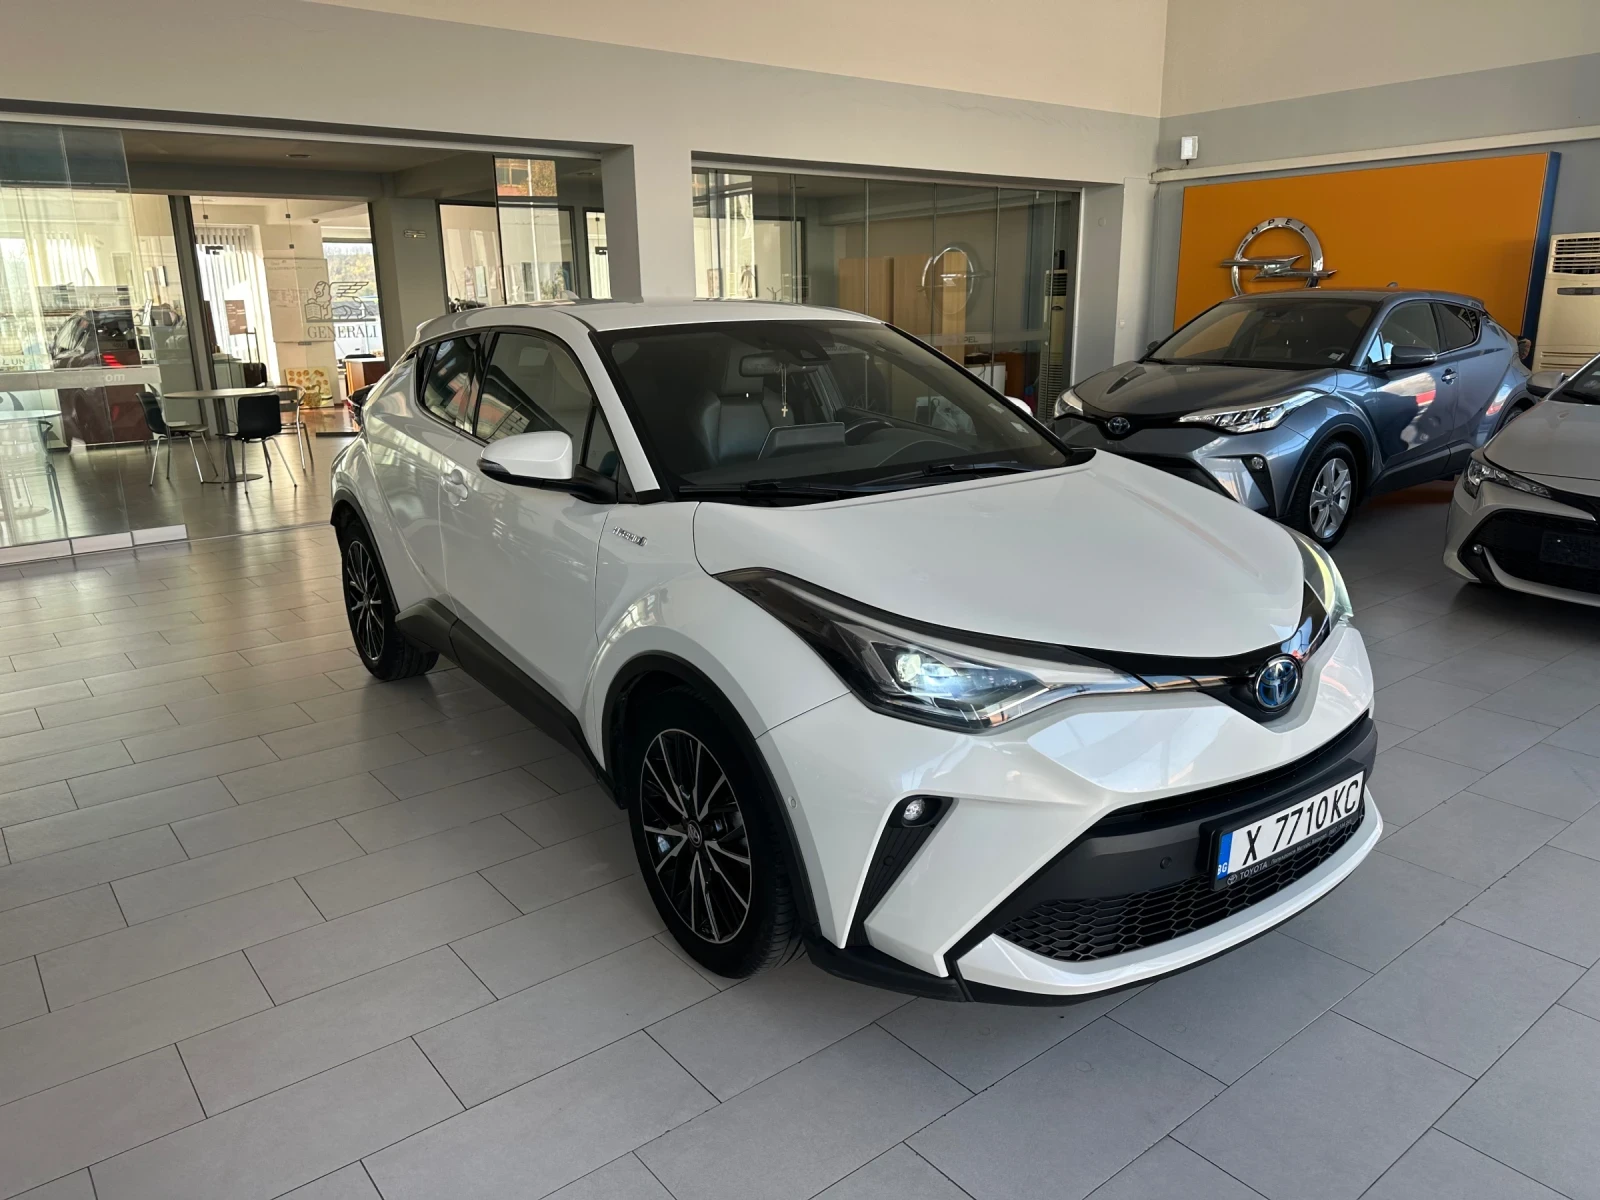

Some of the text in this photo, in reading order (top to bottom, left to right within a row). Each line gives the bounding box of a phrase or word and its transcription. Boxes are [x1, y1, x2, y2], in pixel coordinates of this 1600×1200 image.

[1251, 218, 1306, 235] OPEL
[307, 325, 379, 339] GENERALI
[1242, 824, 1262, 866] X
[1240, 861, 1268, 880] TOYOTA
